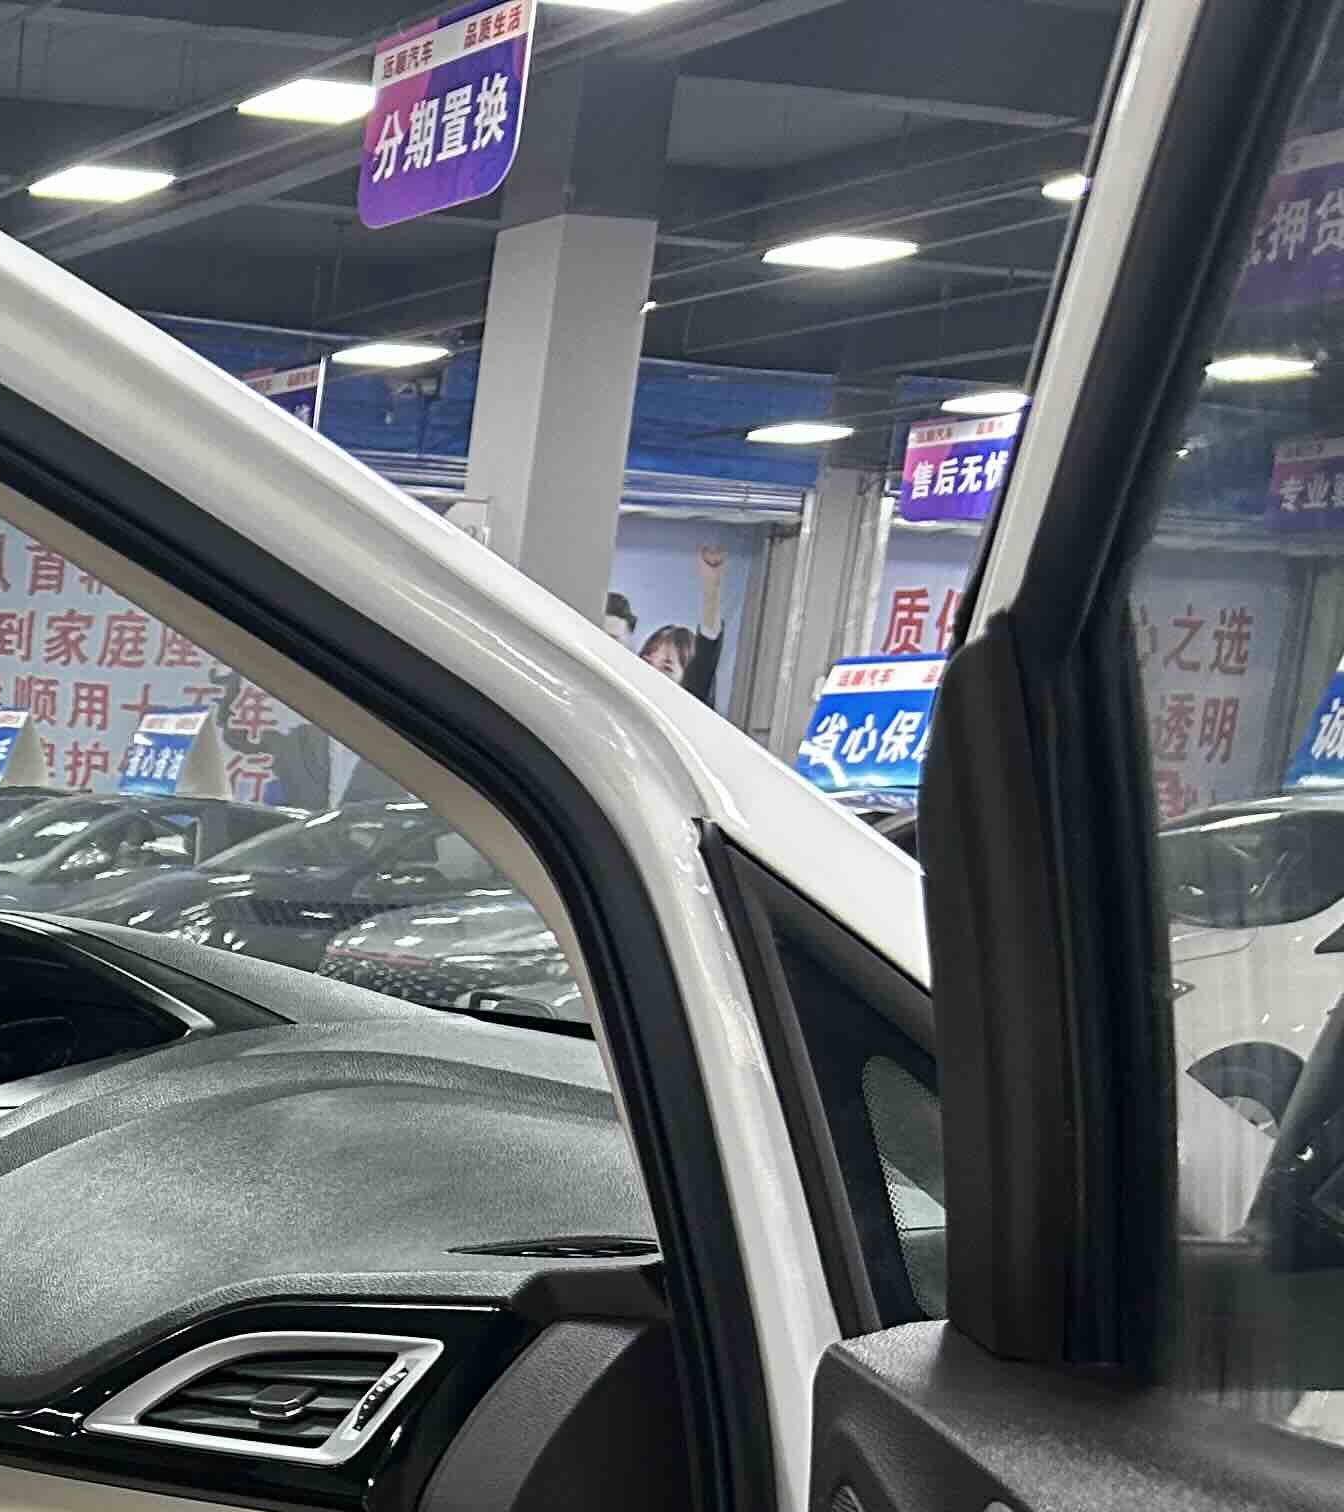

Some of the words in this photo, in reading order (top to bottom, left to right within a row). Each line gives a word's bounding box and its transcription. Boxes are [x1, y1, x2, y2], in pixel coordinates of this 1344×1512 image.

[382, 40, 433, 79] 远顺汽车
[464, 4, 523, 49] 品质生活
[372, 72, 509, 183] 分期置换
[912, 450, 1009, 500] 售后无忧
